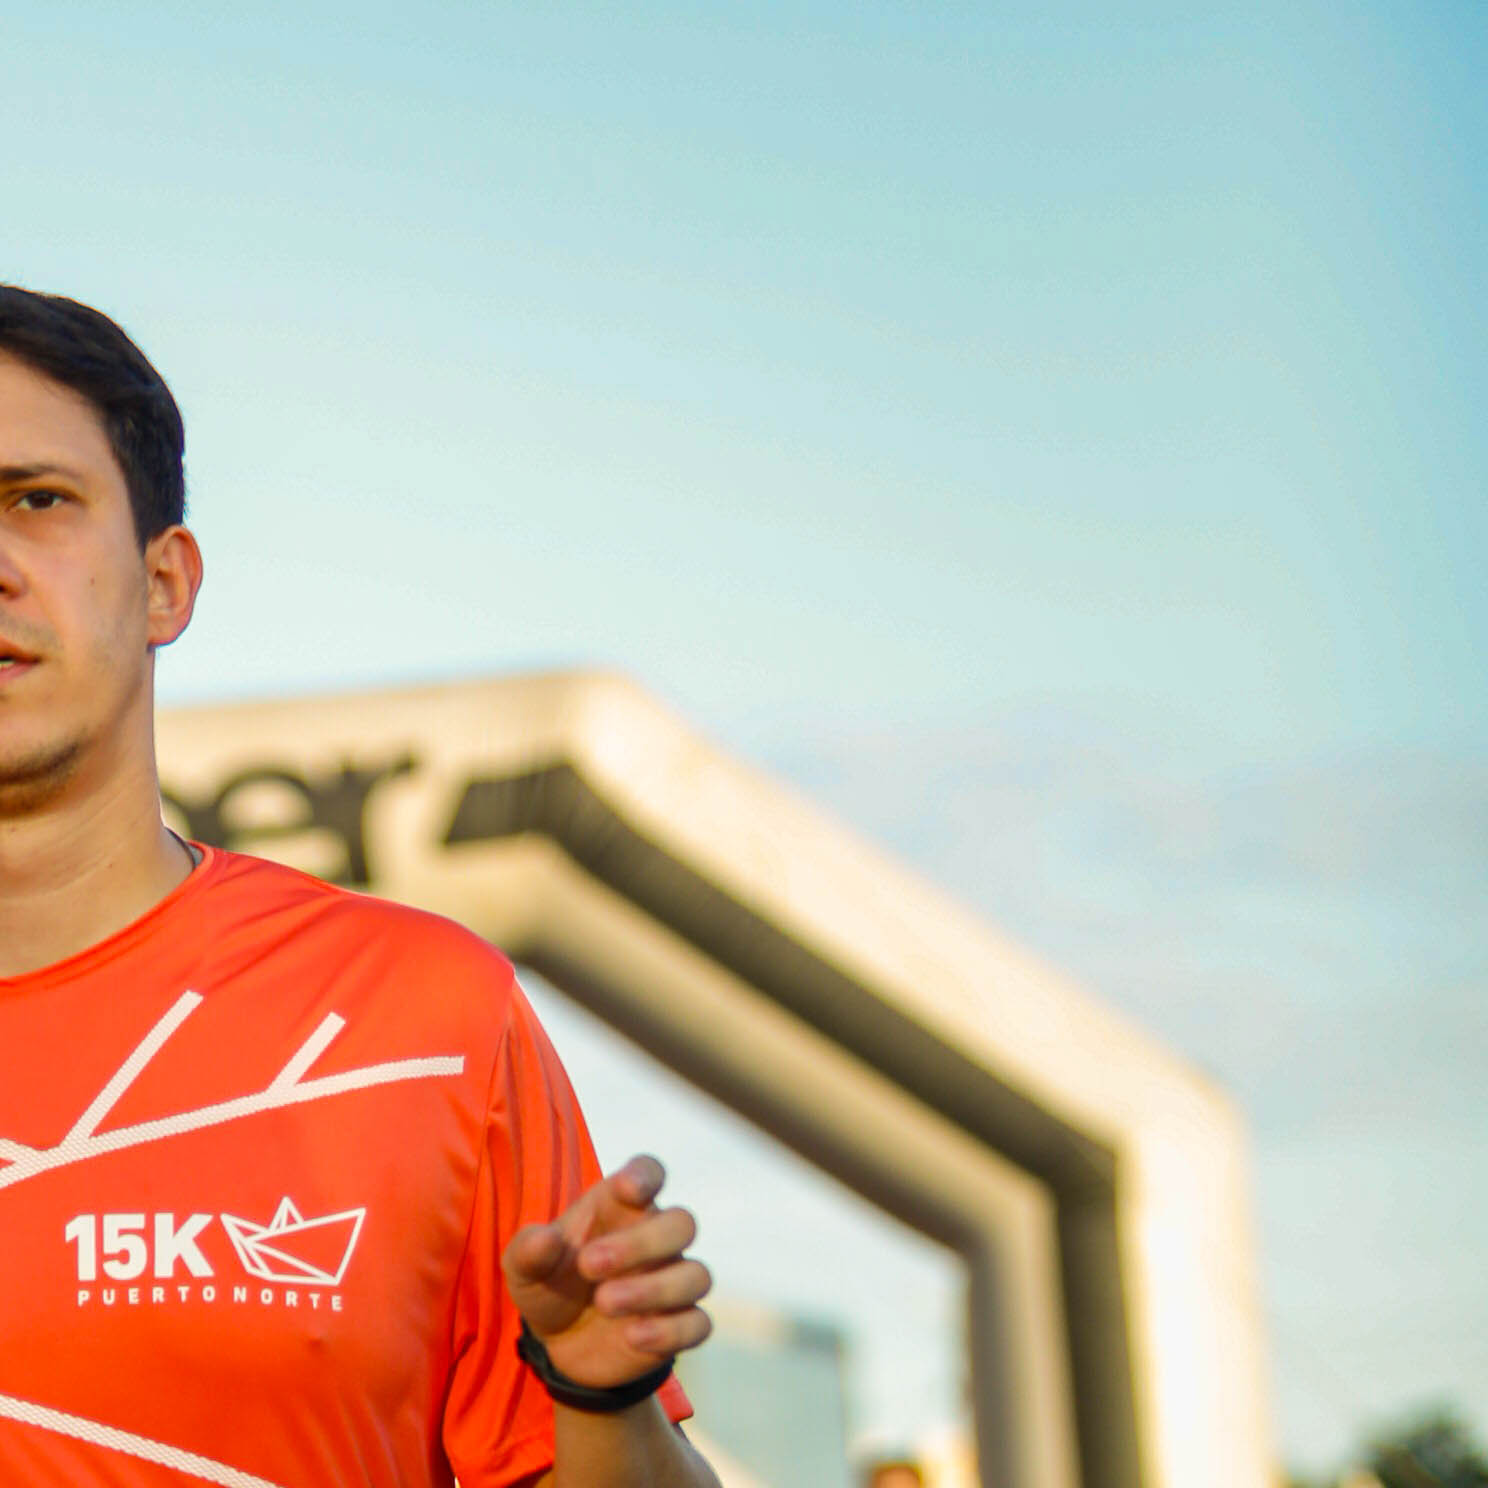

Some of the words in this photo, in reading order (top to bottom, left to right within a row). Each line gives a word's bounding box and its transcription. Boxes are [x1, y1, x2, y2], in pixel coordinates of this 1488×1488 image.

[65, 1212, 214, 1281] 15K
[78, 1286, 216, 1306] PUERTO
[234, 1285, 342, 1311] NORTE
